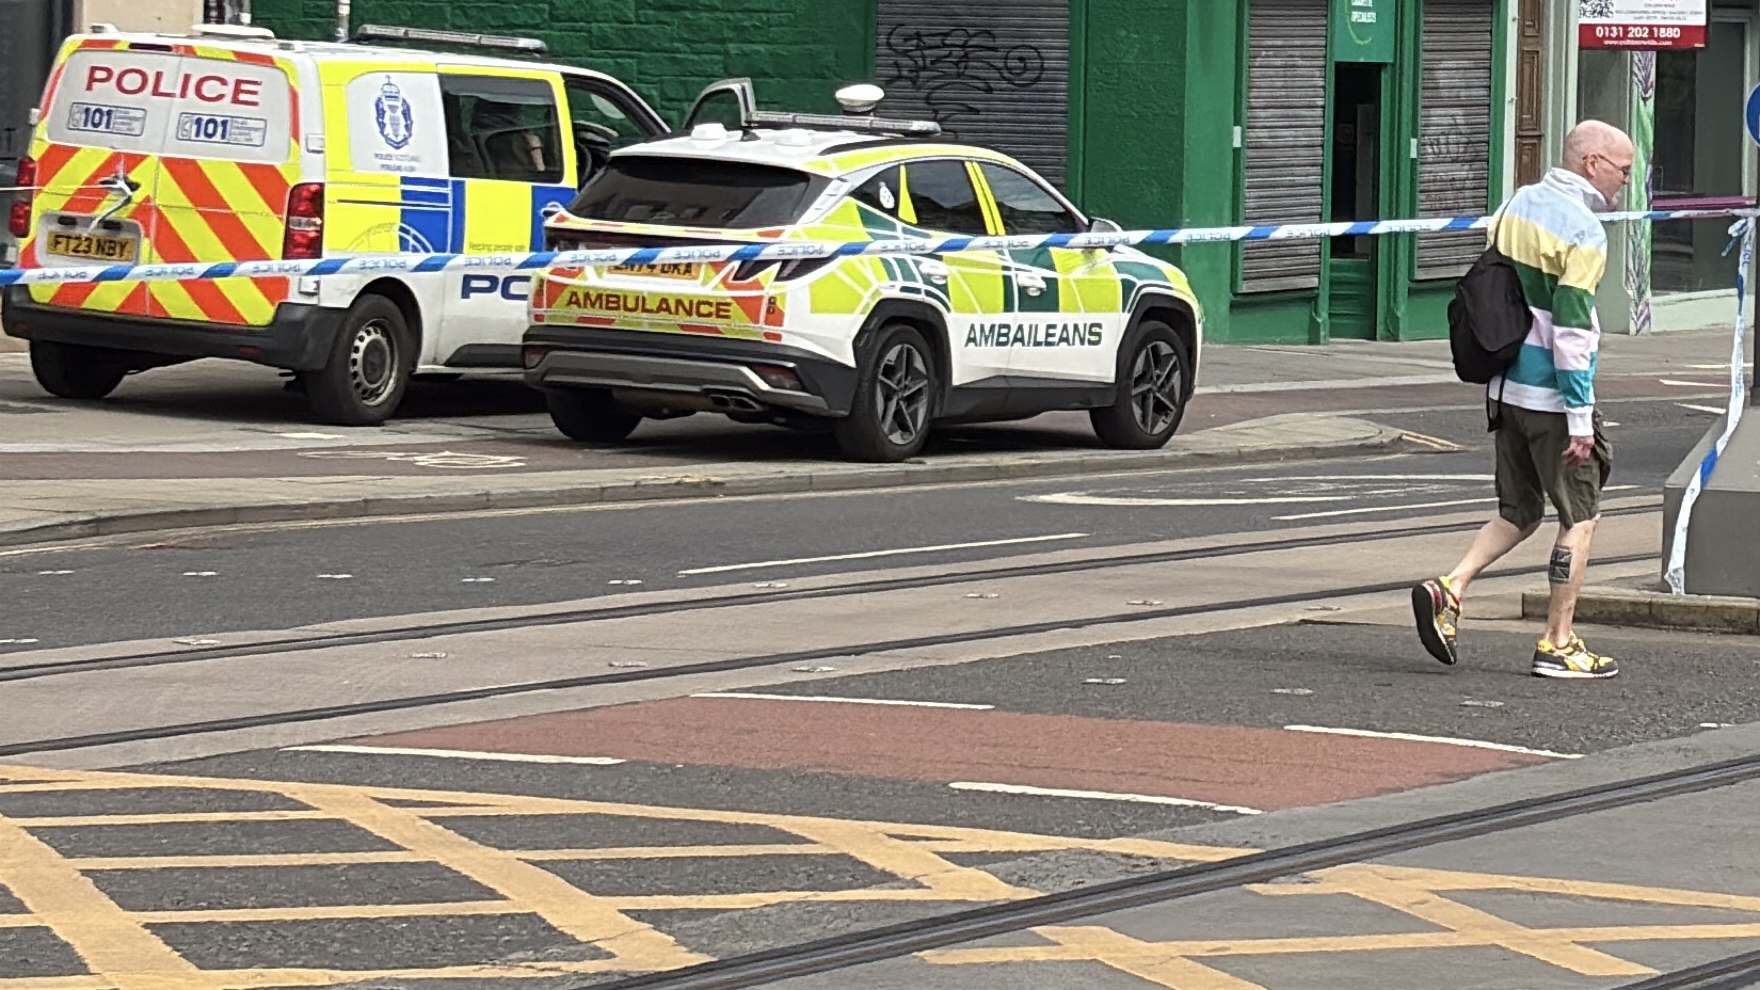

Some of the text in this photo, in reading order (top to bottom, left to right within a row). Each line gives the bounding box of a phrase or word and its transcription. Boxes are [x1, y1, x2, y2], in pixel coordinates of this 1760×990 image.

[1595, 26, 1624, 38] 0131
[1627, 27, 1649, 38] 202
[85, 65, 264, 107] POLICE
[83, 107, 114, 130] 101
[194, 116, 230, 140] 101
[53, 233, 130, 258] FT23 NBY
[674, 247, 721, 259] POLICE
[777, 245, 825, 256] POLICE
[359, 260, 407, 270] POLICE
[565, 290, 733, 320] AMBULANCE
[964, 322, 1103, 348] AMBAILEANS
